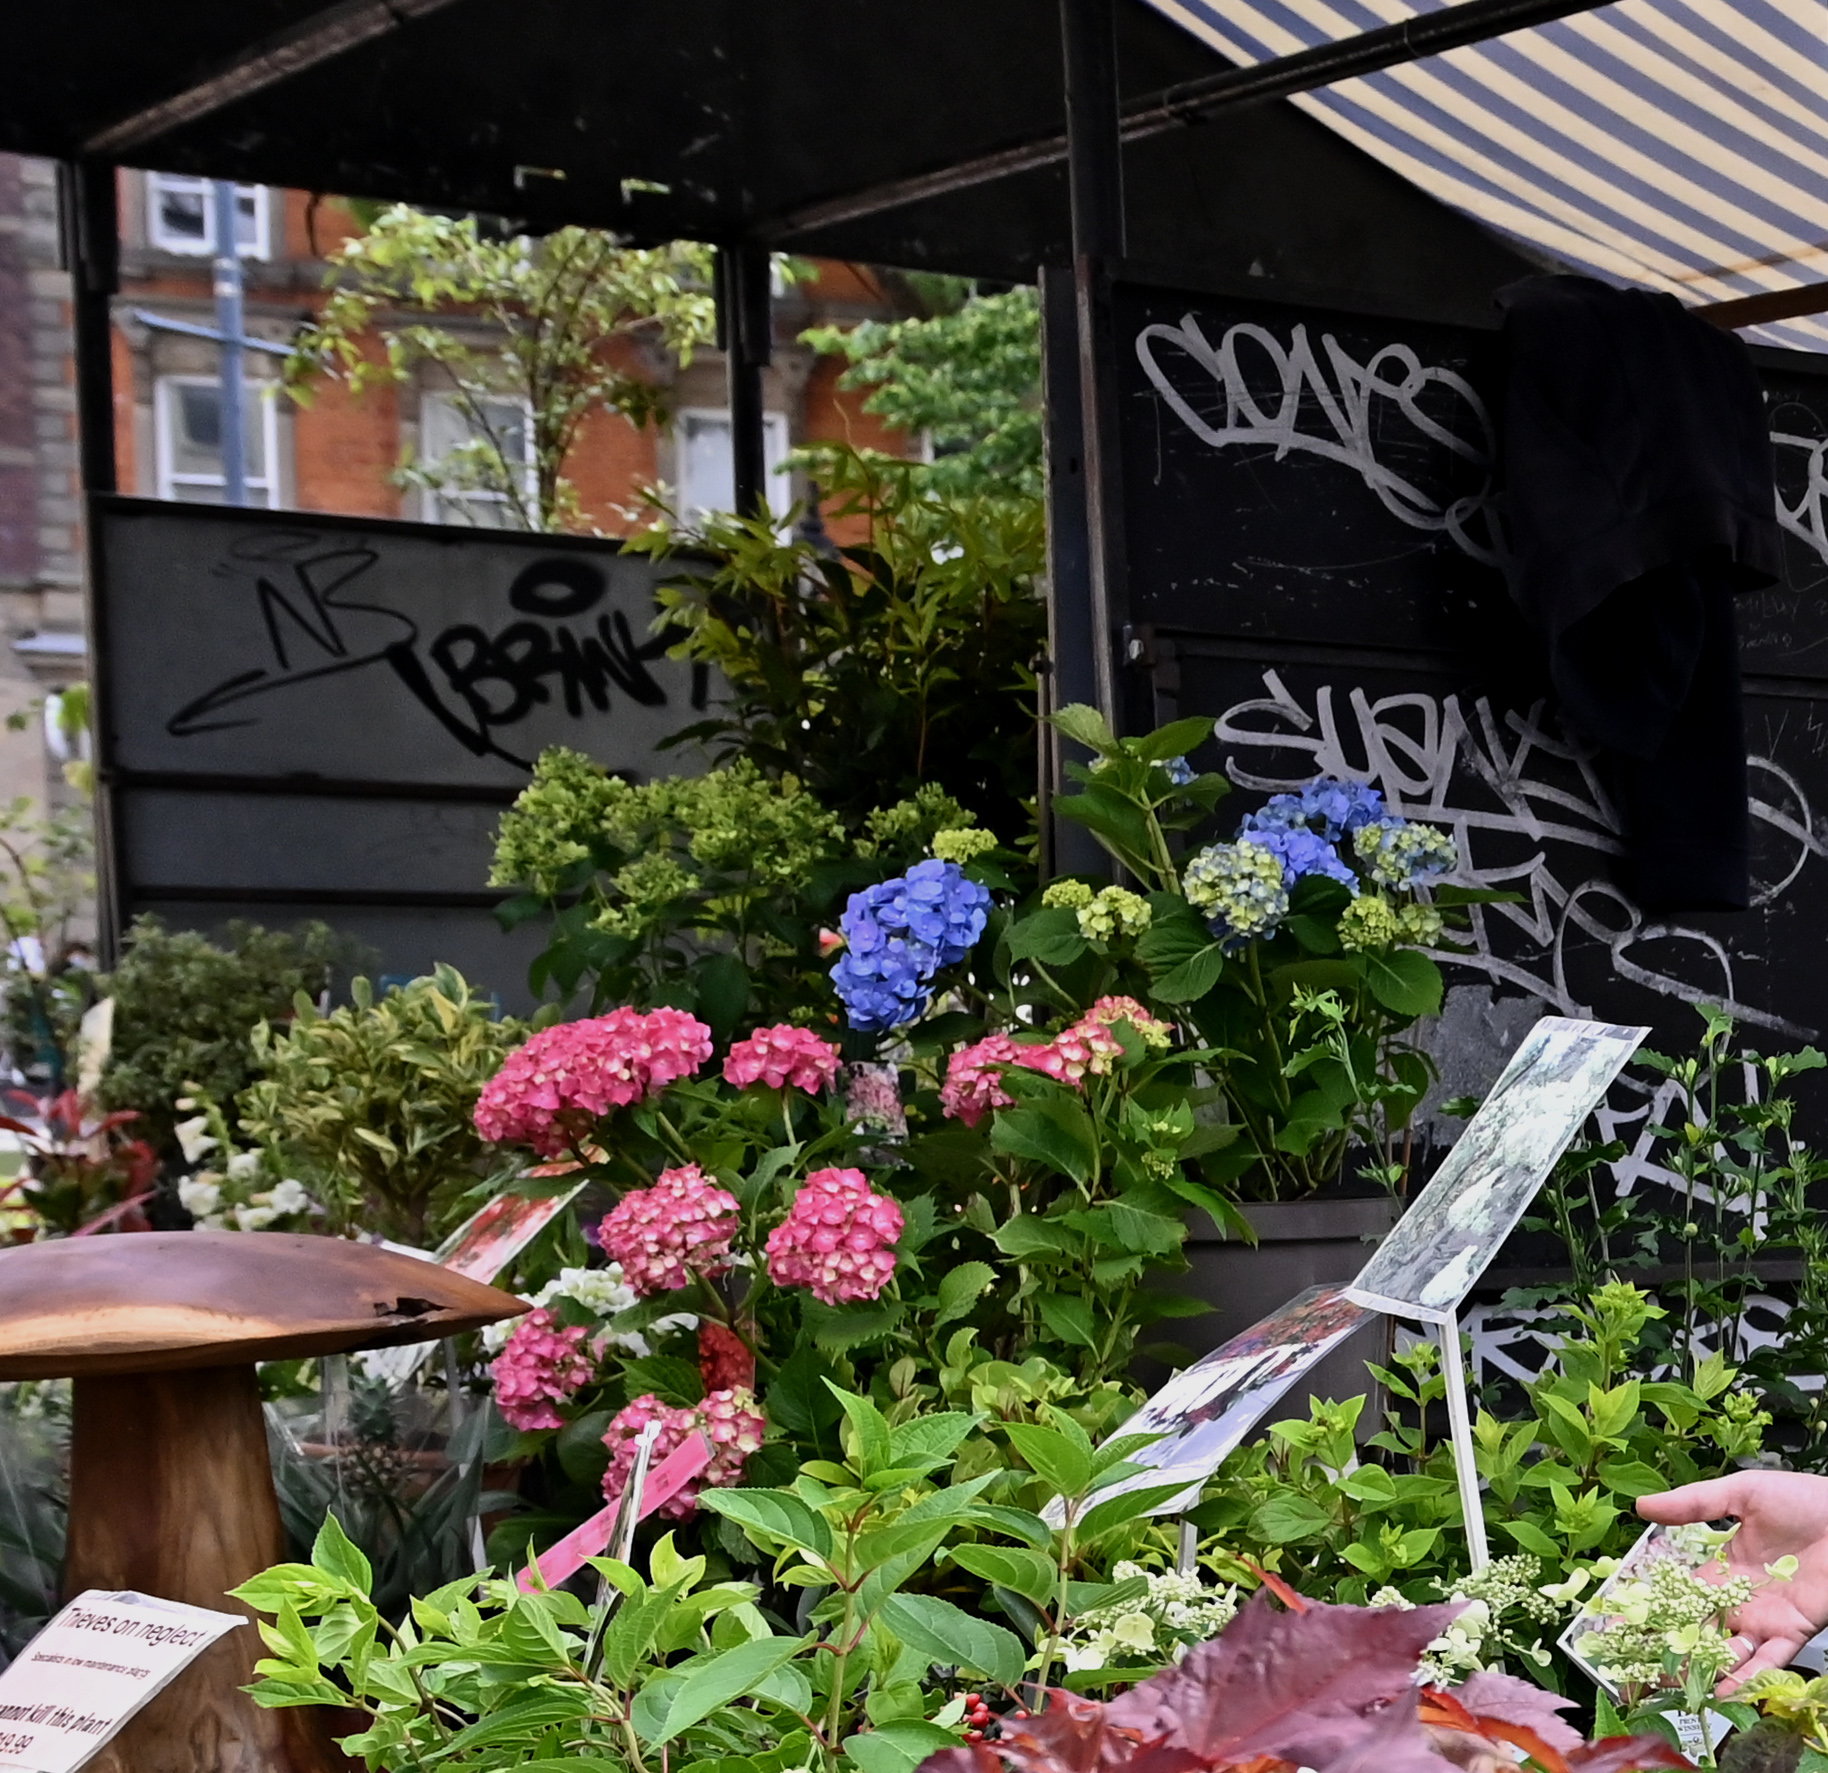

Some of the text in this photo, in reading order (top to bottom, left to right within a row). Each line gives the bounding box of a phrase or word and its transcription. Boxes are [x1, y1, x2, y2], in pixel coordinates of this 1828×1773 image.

[113, 1619, 141, 1637] on
[135, 1624, 208, 1647] neglect
[25, 1703, 57, 1724] kill
[45, 1707, 75, 1729] this
[64, 1712, 113, 1736] plant
